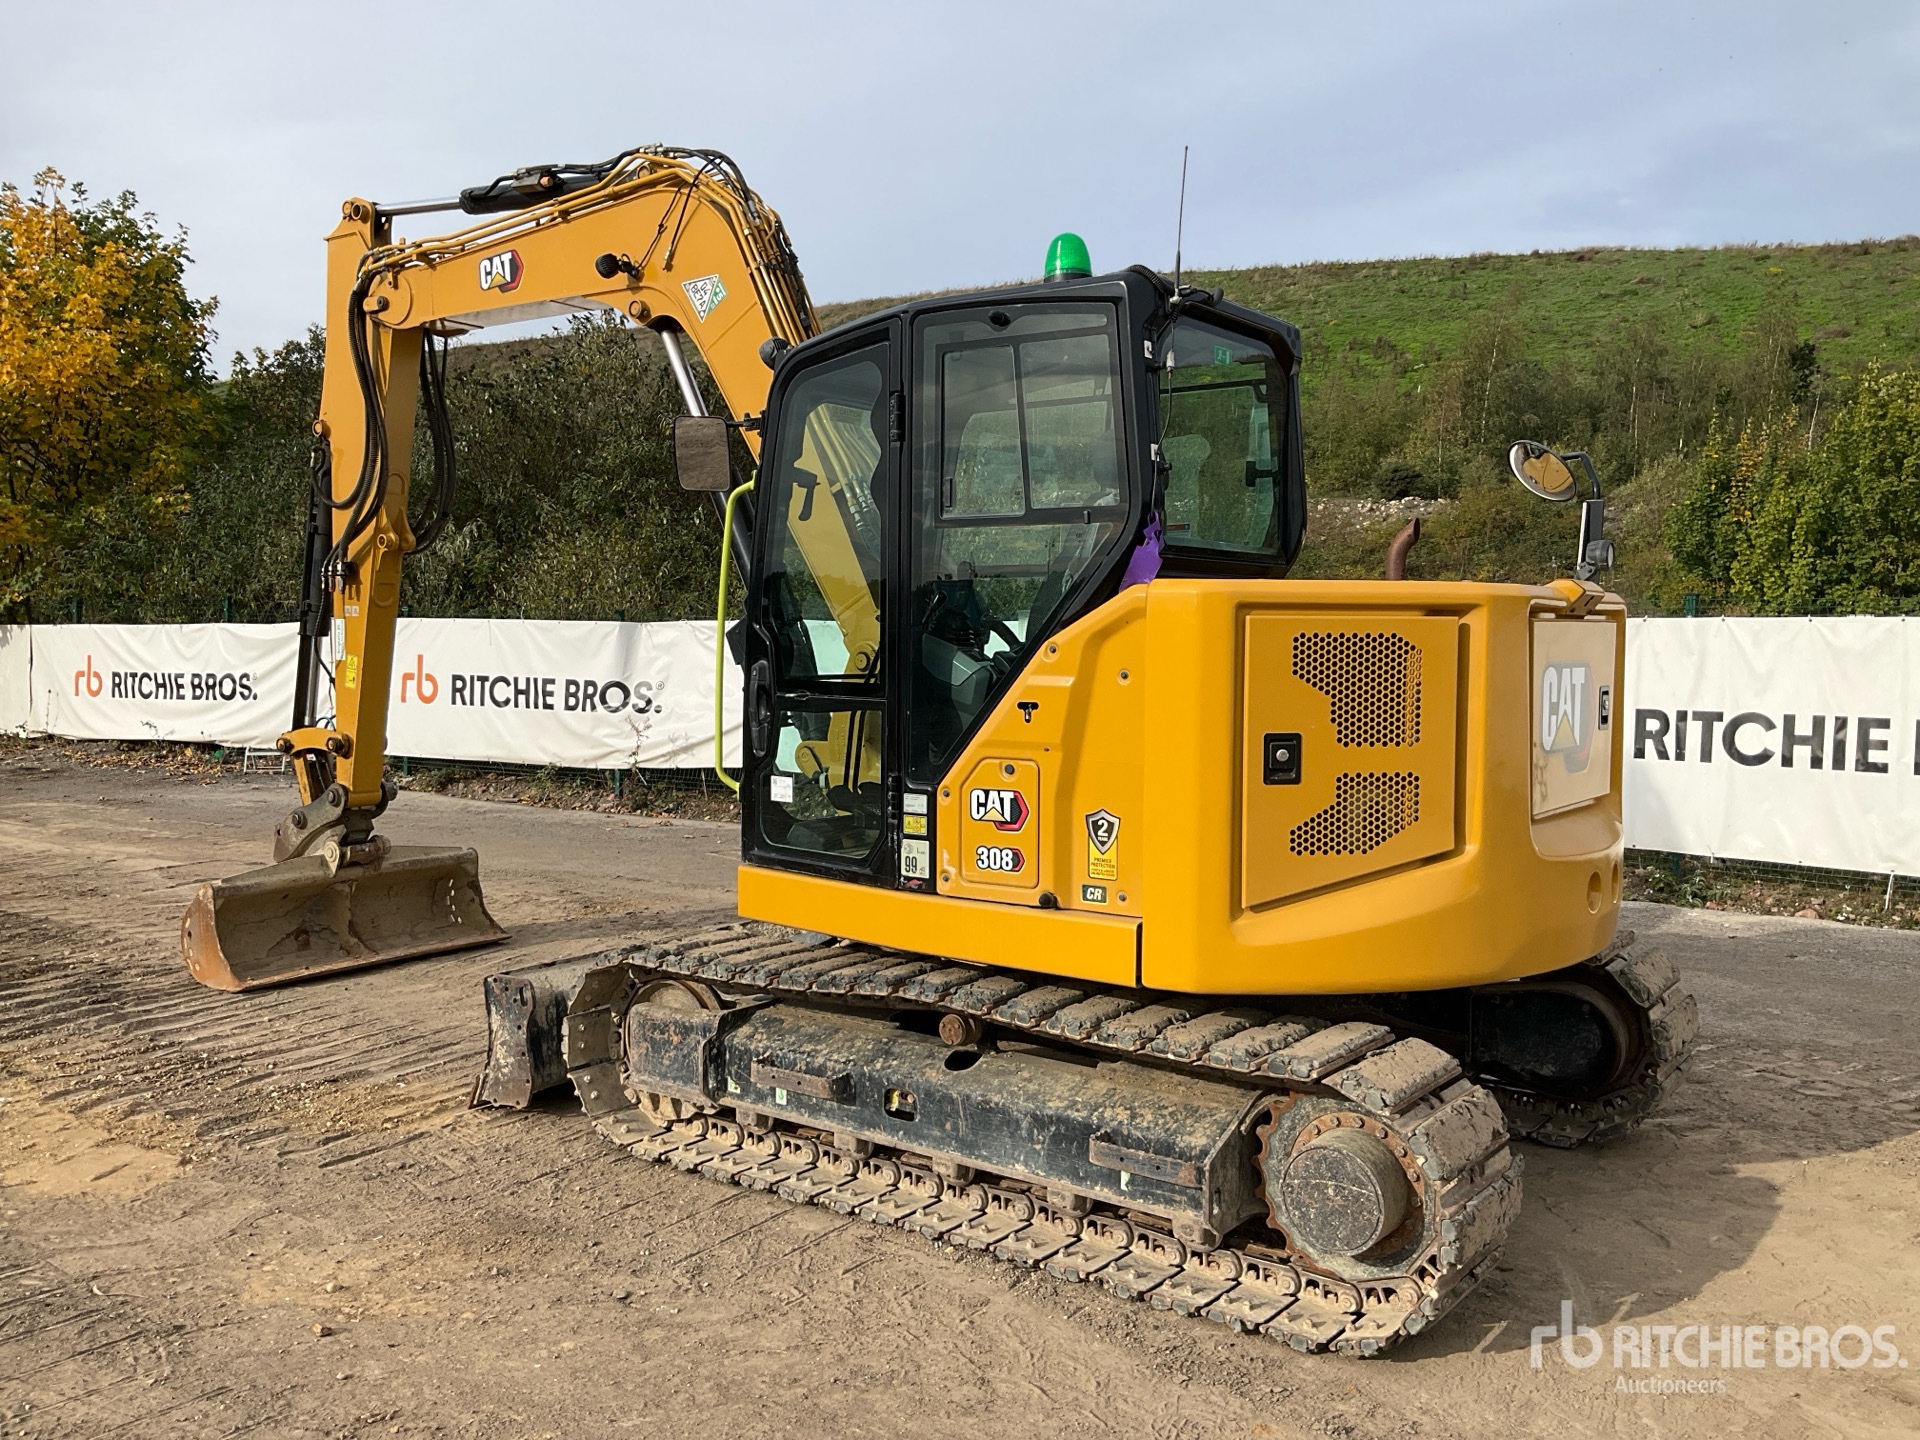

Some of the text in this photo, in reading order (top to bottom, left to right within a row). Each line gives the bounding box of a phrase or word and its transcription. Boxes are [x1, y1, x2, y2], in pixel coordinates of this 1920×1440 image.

[480, 251, 513, 290] CAT
[74, 655, 102, 697] rb
[111, 671, 186, 700] RITCHIE
[400, 654, 439, 704] rb
[450, 674, 556, 710] RITCHIE
[1542, 665, 1586, 751] CAT
[1633, 708, 1891, 774] RITCHIE
[971, 789, 1014, 822] CAT
[1097, 819, 1108, 837] 2
[904, 855, 918, 874] 99
[977, 846, 1013, 871] 308
[1086, 887, 1103, 901] CR
